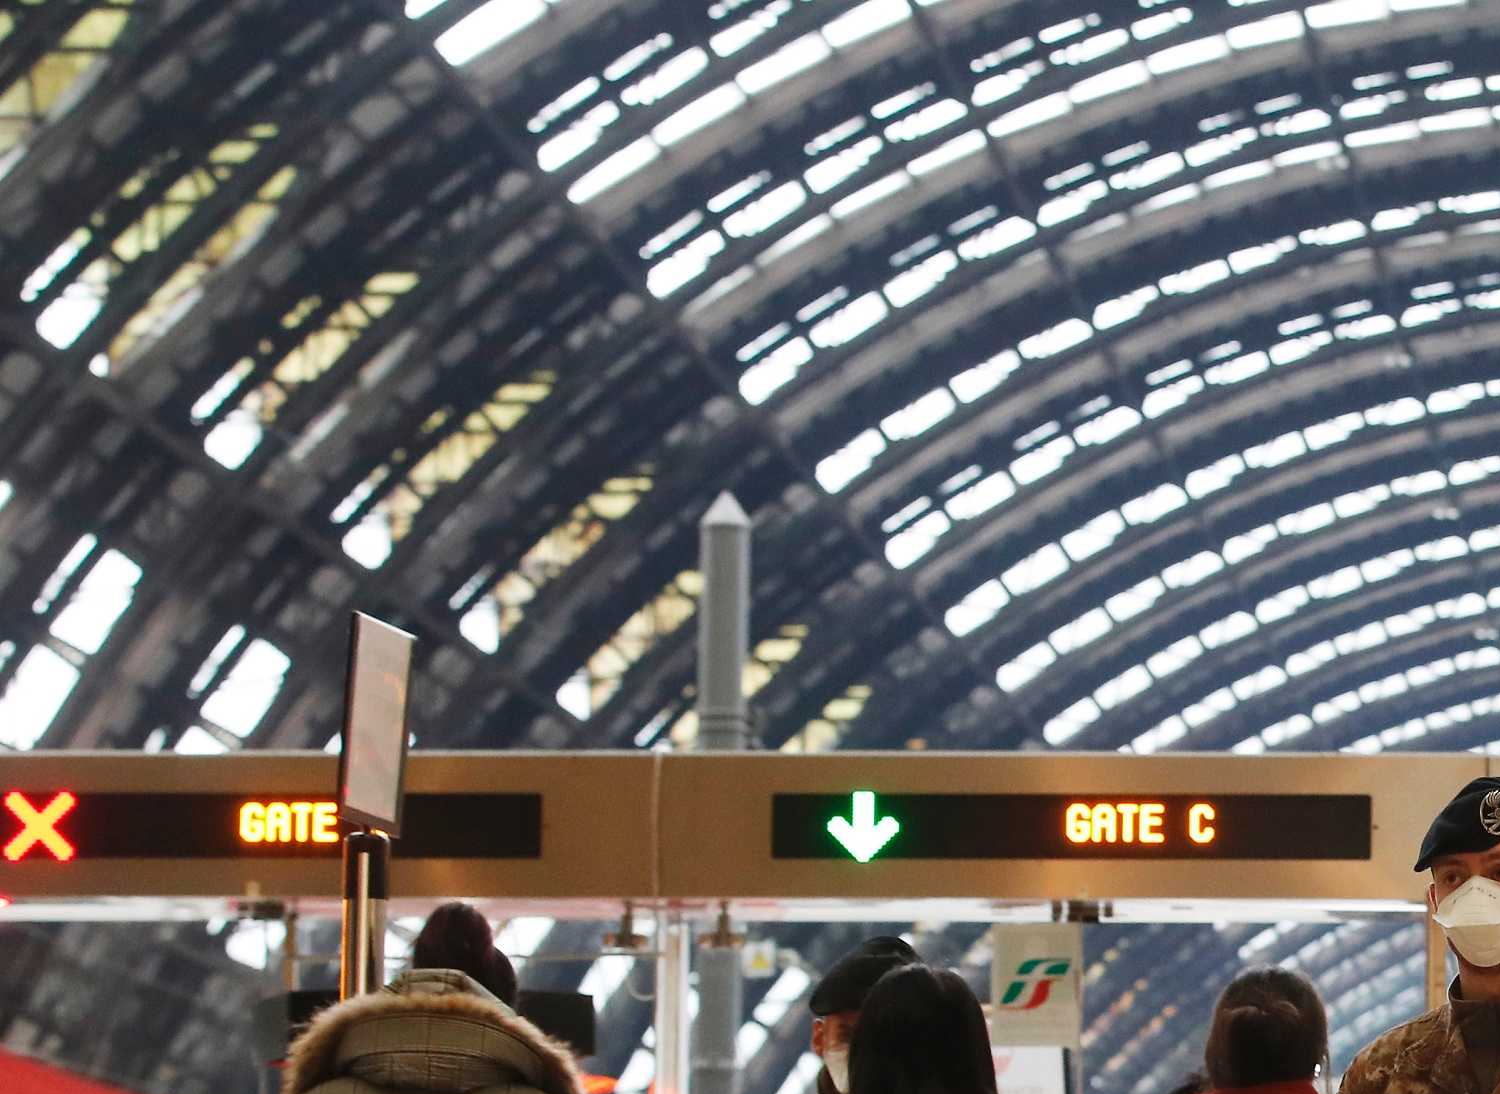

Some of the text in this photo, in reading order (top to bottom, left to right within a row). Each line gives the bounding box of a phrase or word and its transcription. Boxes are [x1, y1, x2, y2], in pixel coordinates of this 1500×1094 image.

[238, 801, 339, 845] GATE
[1064, 801, 1216, 845] GATE C
